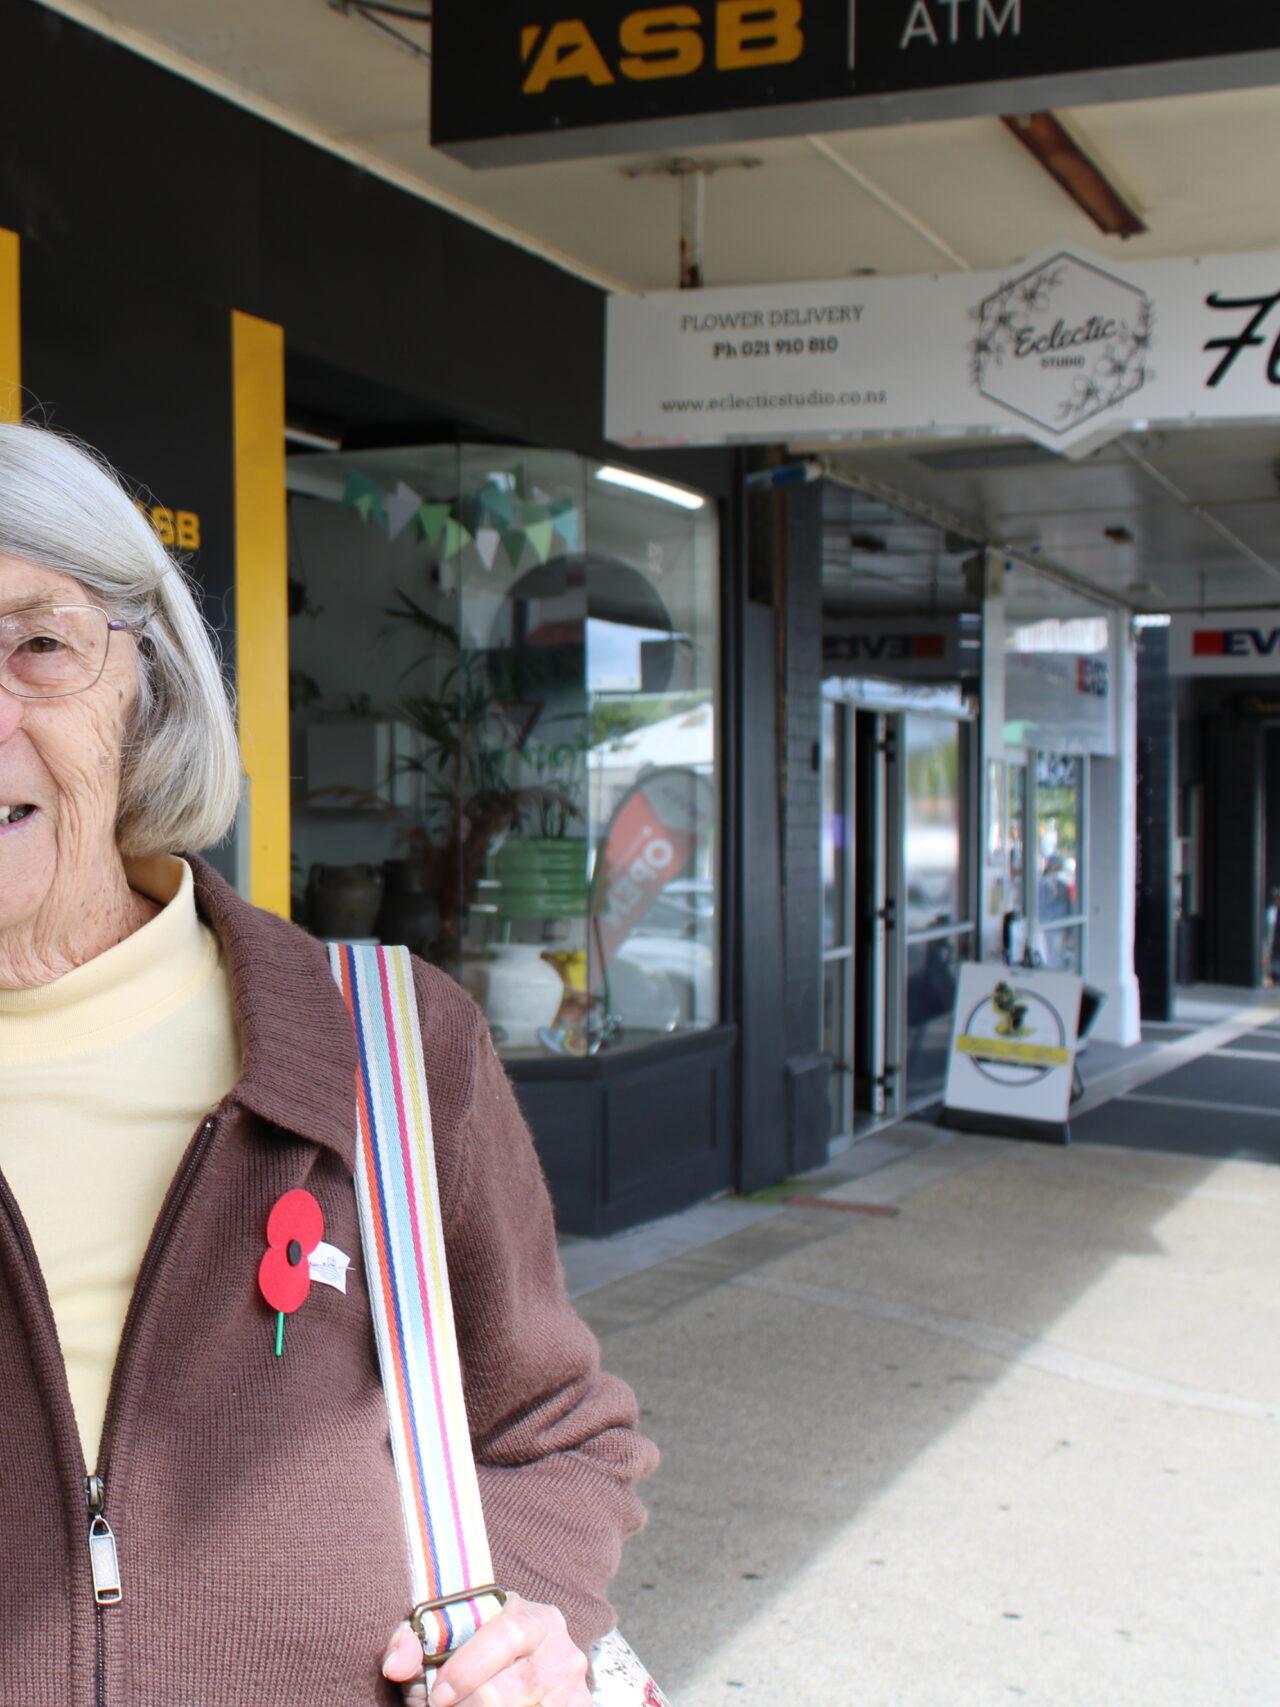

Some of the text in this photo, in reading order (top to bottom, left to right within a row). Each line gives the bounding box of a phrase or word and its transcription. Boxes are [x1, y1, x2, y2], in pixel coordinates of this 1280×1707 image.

[899, 0, 1022, 50] ATM
[521, 0, 805, 94] ASB
[680, 304, 865, 332] FLOWER DELIVERY
[712, 336, 839, 358] Ph 021 910 810
[1013, 315, 1118, 358] Eclectic
[1040, 355, 1086, 369] STUDIO
[660, 389, 888, 413] www.eclecticstudio.co.nz
